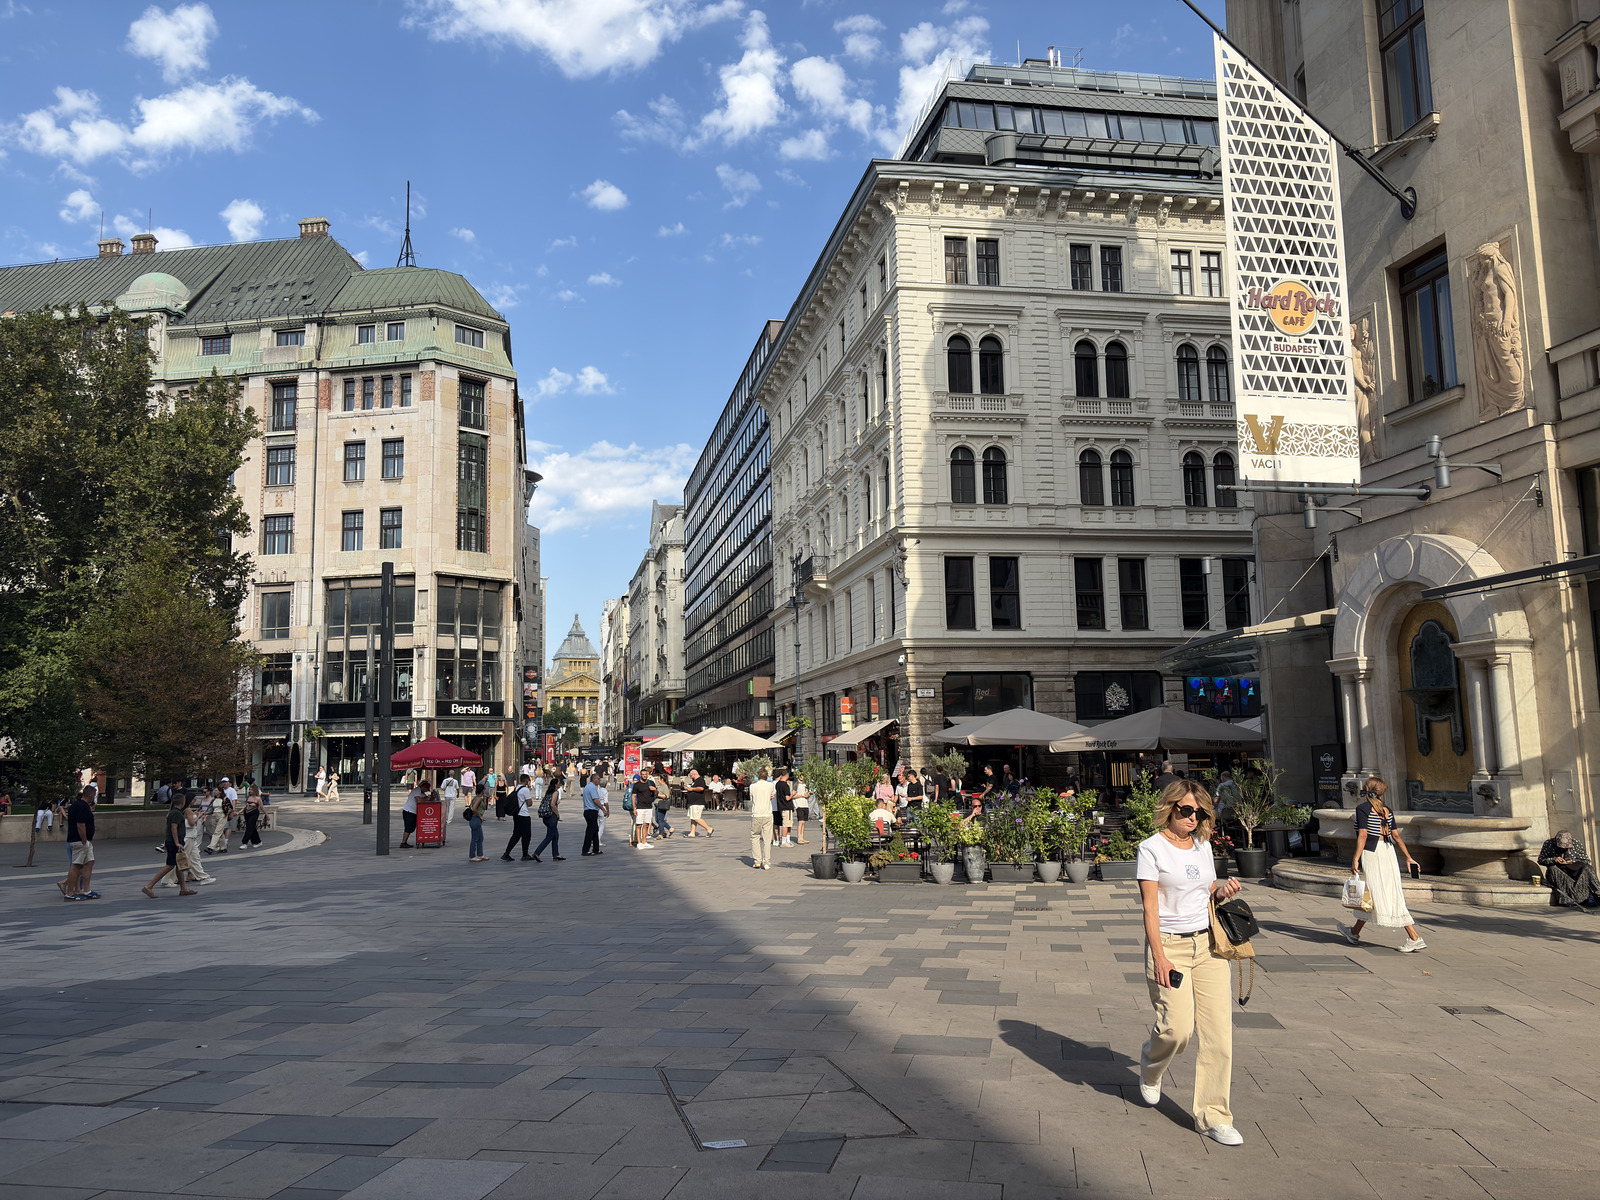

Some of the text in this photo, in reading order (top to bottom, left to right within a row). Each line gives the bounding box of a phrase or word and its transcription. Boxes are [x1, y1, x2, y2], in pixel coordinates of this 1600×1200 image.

[1247, 287, 1336, 317] Hard Rock
[1282, 315, 1306, 327] CAFE
[1273, 343, 1318, 354] BUDAPEST
[1251, 458, 1276, 469] VÁCI
[451, 703, 490, 715] Bershka
[1085, 740, 1117, 749] Hard Rock Cafe
[1205, 739, 1242, 748] Hard Rock Cafe
